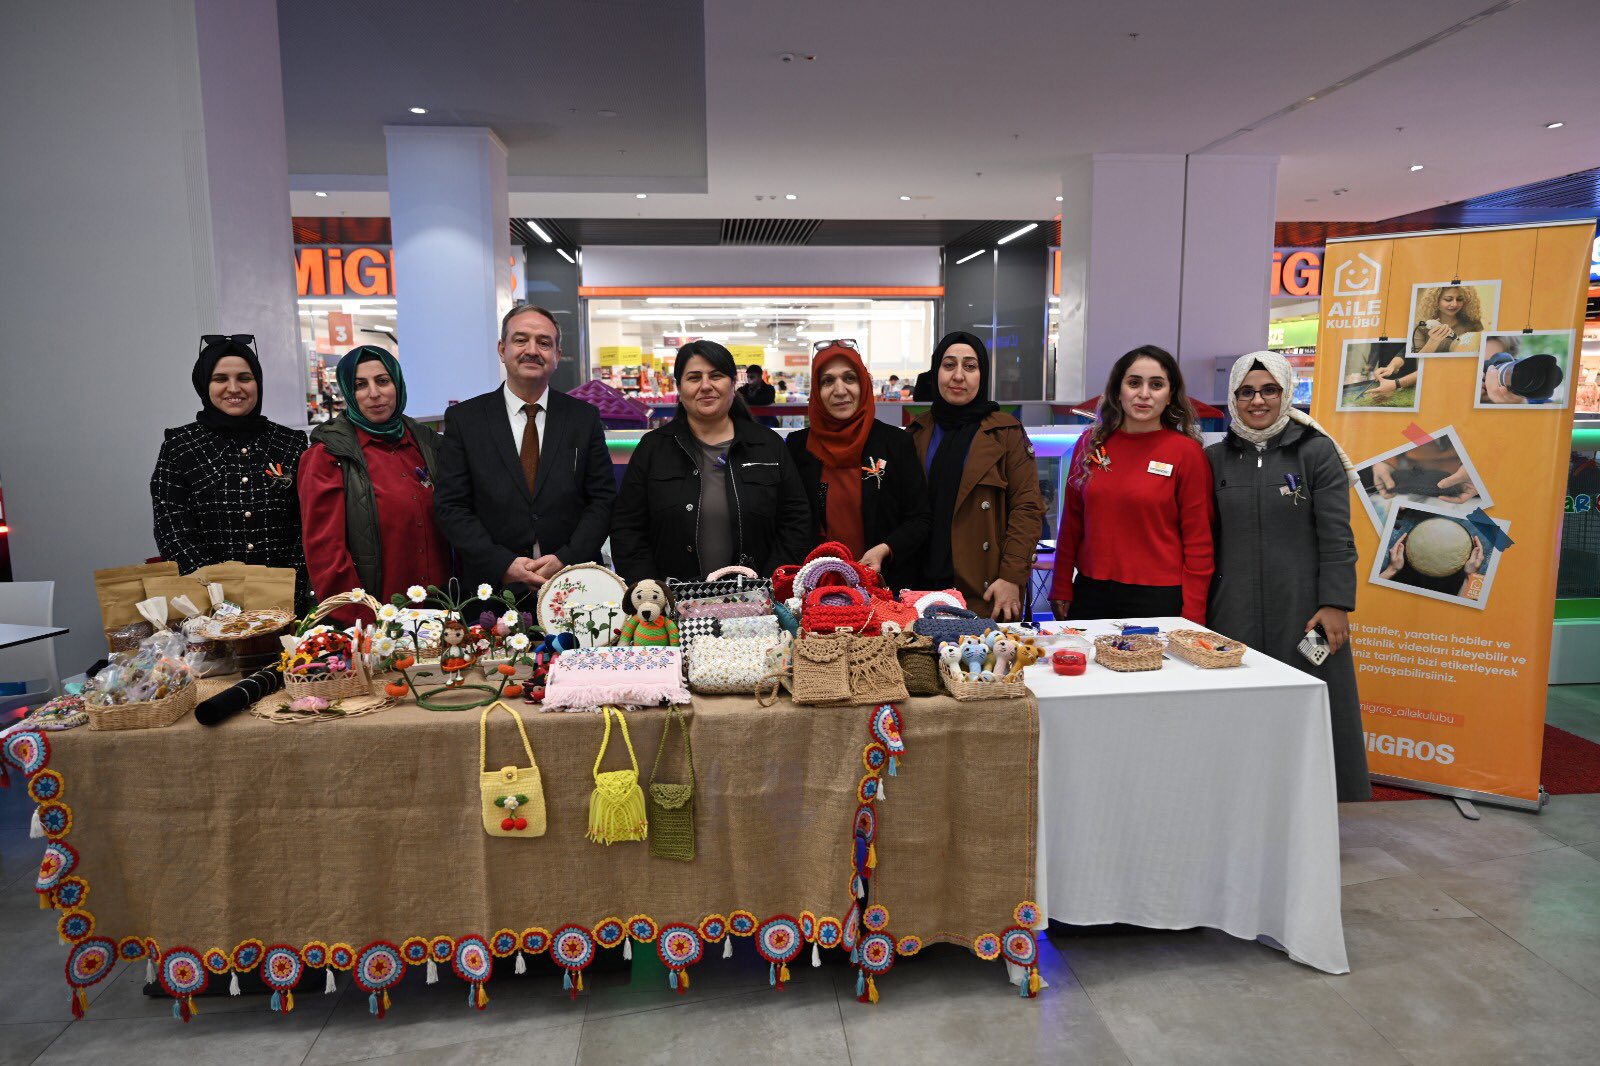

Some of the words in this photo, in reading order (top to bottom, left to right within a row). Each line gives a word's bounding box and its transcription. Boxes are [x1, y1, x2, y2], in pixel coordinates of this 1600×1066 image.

[295, 248, 397, 296] MiG
[335, 325, 348, 342] 3
[1326, 315, 1381, 329] KULÜBÜ
[1362, 624, 1401, 638] tarifler,
[1404, 630, 1448, 643] yaratıcı
[1450, 633, 1494, 647] hobiler
[1496, 640, 1511, 649] ve
[1355, 636, 1395, 649] etkinlik
[1398, 641, 1448, 655] videoları
[1451, 647, 1509, 663] izleyebilir
[1511, 655, 1527, 665] ve
[1374, 651, 1415, 664] tarifleri
[1417, 658, 1438, 667] bizi
[1440, 660, 1519, 677] etiketleyerek
[1363, 731, 1455, 765] iGROS
